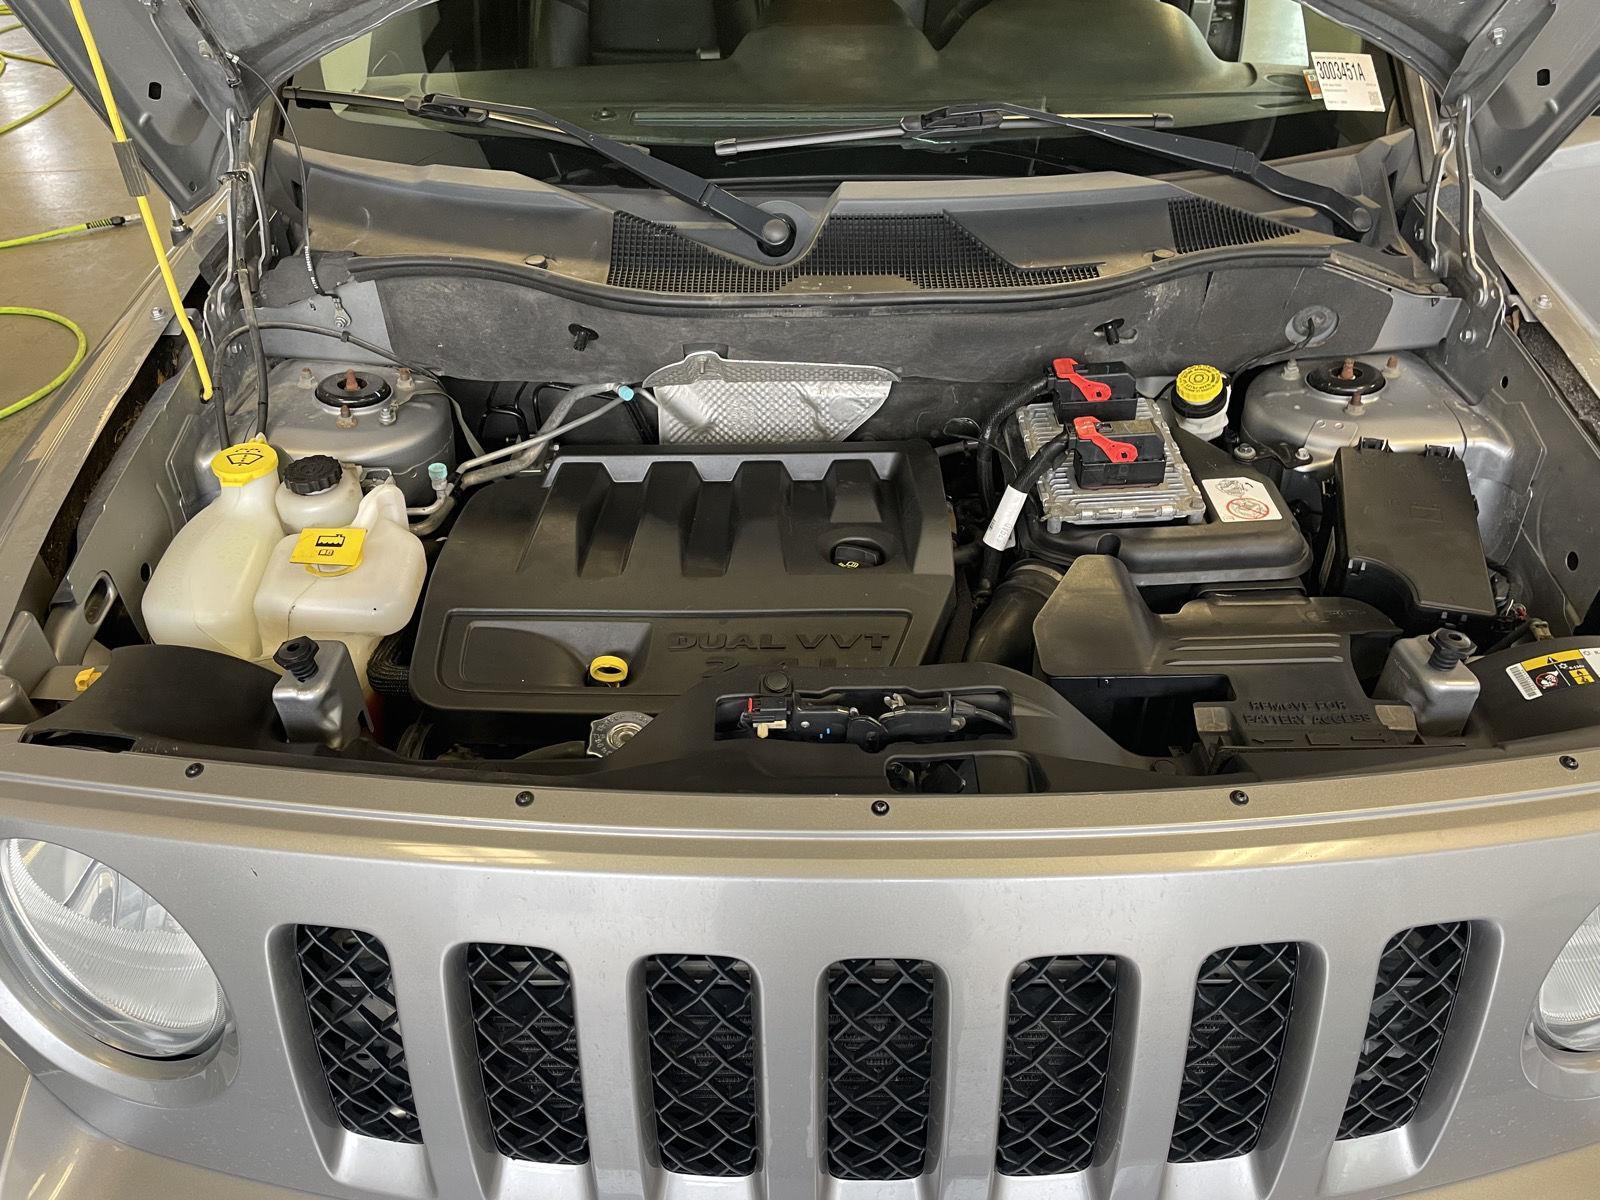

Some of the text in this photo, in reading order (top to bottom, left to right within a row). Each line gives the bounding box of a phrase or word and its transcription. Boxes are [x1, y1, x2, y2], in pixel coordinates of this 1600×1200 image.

[1317, 61, 1366, 81] 3003451A
[668, 632, 891, 650] DUAL VVT
[1314, 700, 1347, 712] FOR
[1242, 713, 1305, 725] BATTERY
